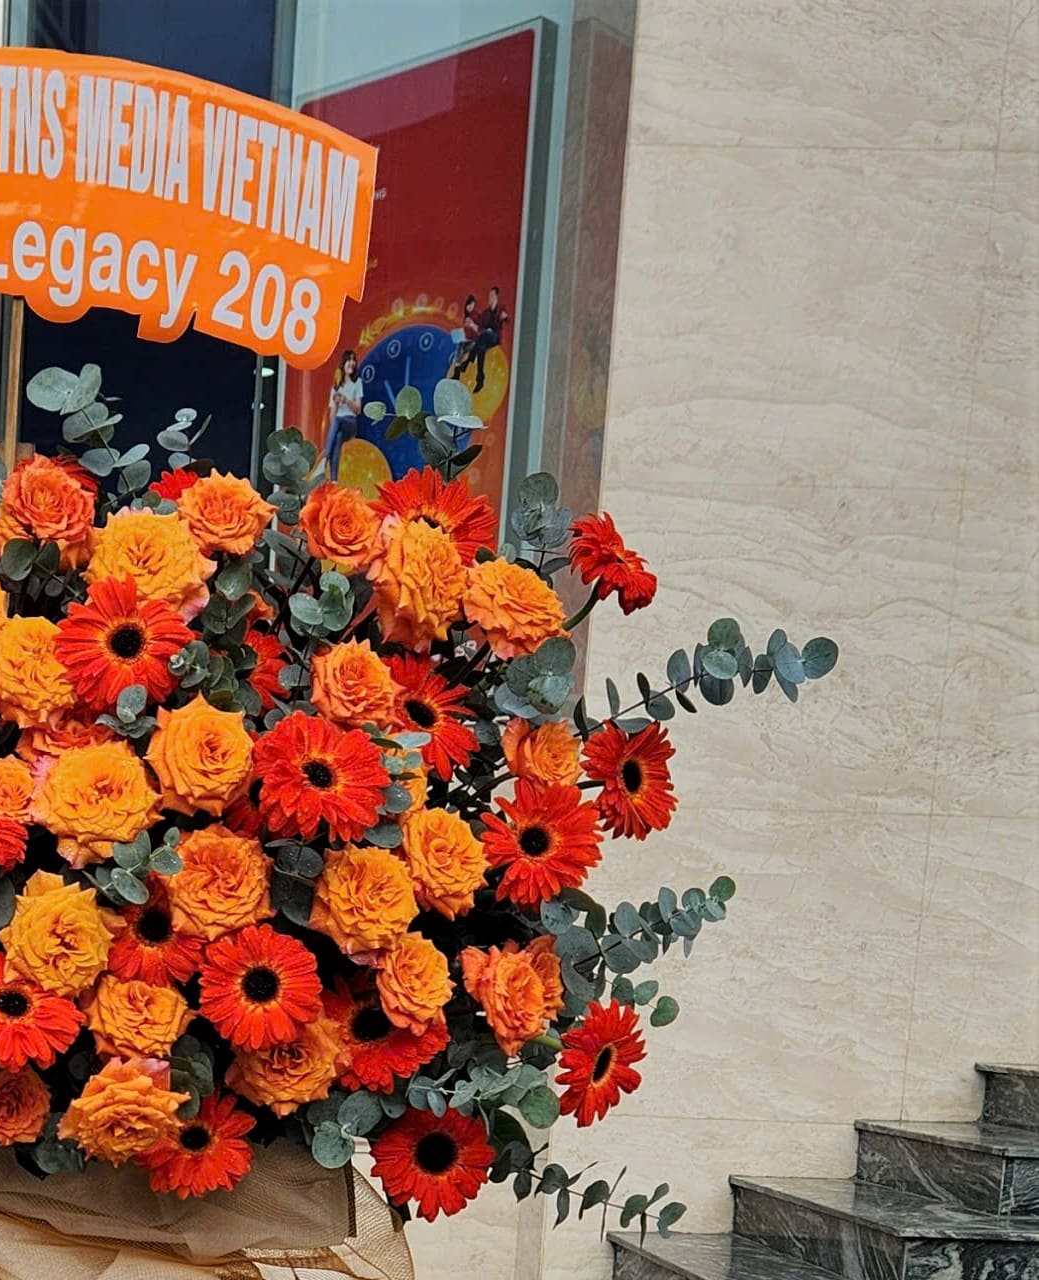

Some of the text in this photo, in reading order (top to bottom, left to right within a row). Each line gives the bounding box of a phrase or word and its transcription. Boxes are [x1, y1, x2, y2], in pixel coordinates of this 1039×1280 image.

[74, 74, 191, 205] MEDIA
[201, 102, 360, 264] VIETNAM
[211, 250, 321, 355] 208
